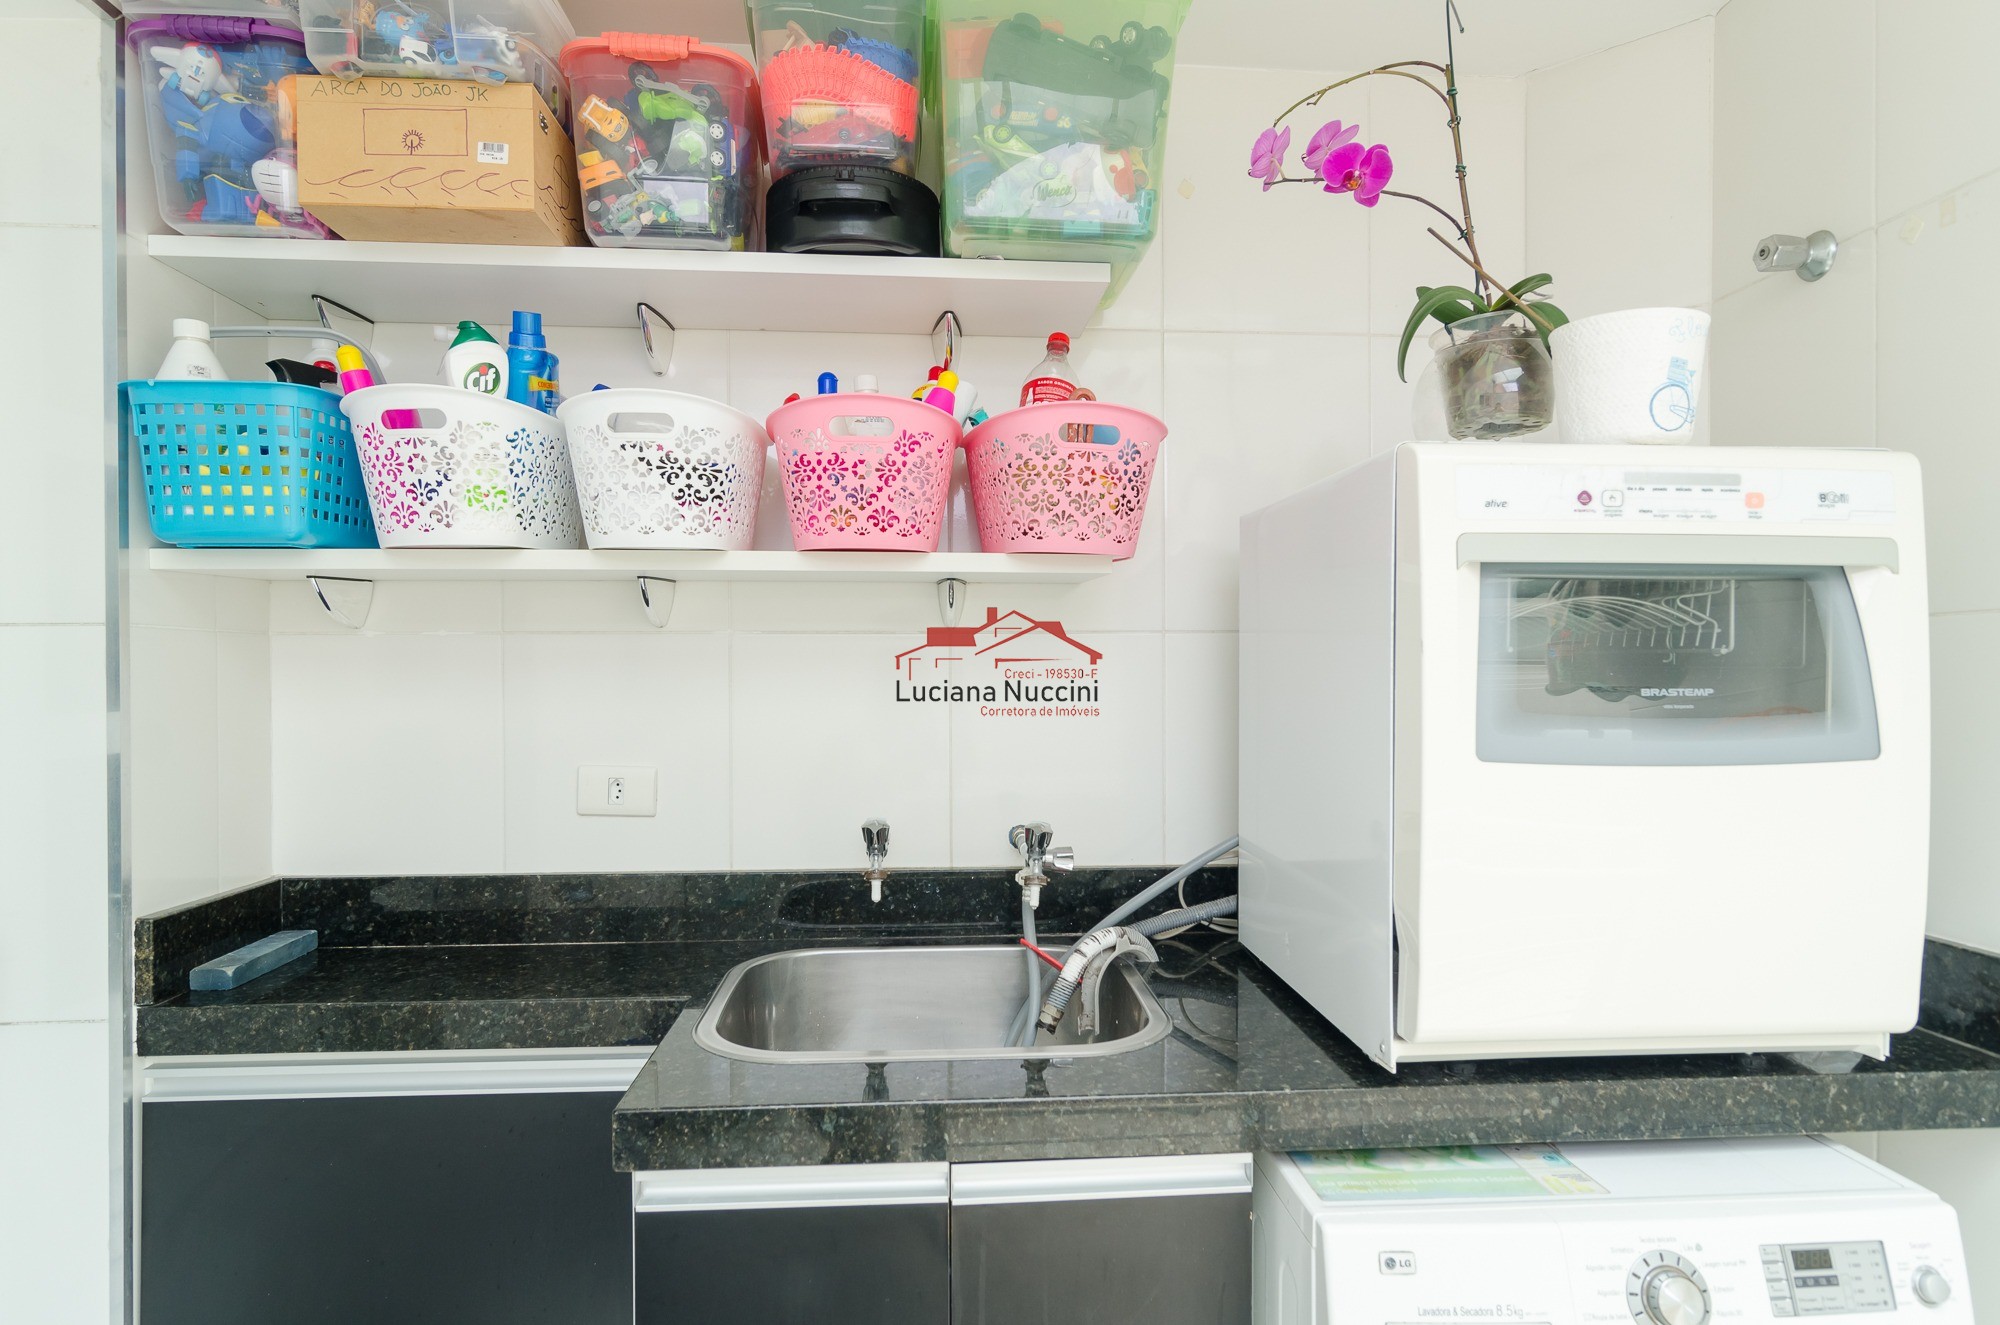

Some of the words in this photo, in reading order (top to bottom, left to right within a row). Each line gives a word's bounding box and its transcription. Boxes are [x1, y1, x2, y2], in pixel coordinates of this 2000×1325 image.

[311, 80, 368, 97] ARCA
[381, 81, 403, 97] DO
[465, 86, 488, 101] JK
[466, 365, 496, 392] Cif
[1640, 688, 1715, 697] BRASTEMP
[1398, 1259, 1412, 1268] LG
[1417, 1305, 1451, 1317] Lavadora
[1453, 1305, 1458, 1317] &
[1459, 1305, 1494, 1317] Secadora
[1495, 1303, 1524, 1319] 8.5kg
